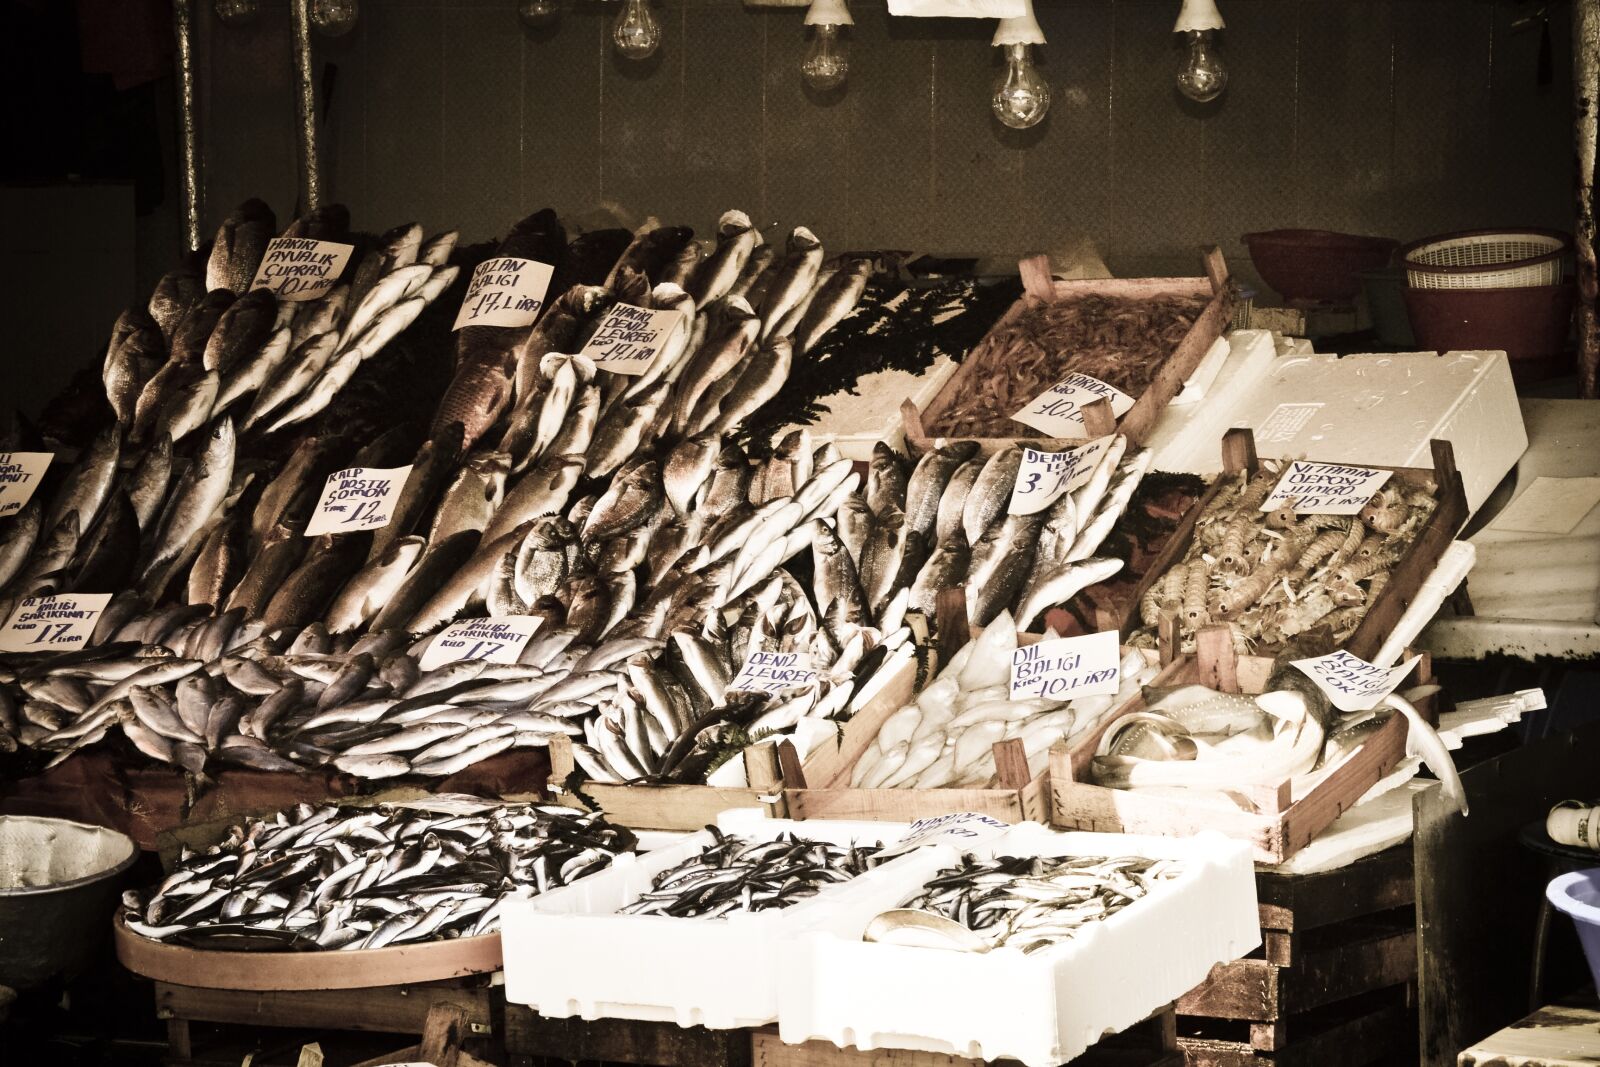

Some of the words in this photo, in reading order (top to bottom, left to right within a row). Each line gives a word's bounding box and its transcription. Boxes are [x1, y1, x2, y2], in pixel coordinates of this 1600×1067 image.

[266, 250, 339, 267] AYVALIK
[328, 468, 364, 484] KALP
[339, 479, 391, 490] DOSTU
[1281, 485, 1356, 496] JUMBO
[324, 487, 391, 506] SOMON
[18, 610, 100, 623] SARIKANAT
[447, 629, 528, 643] SARIKANAT
